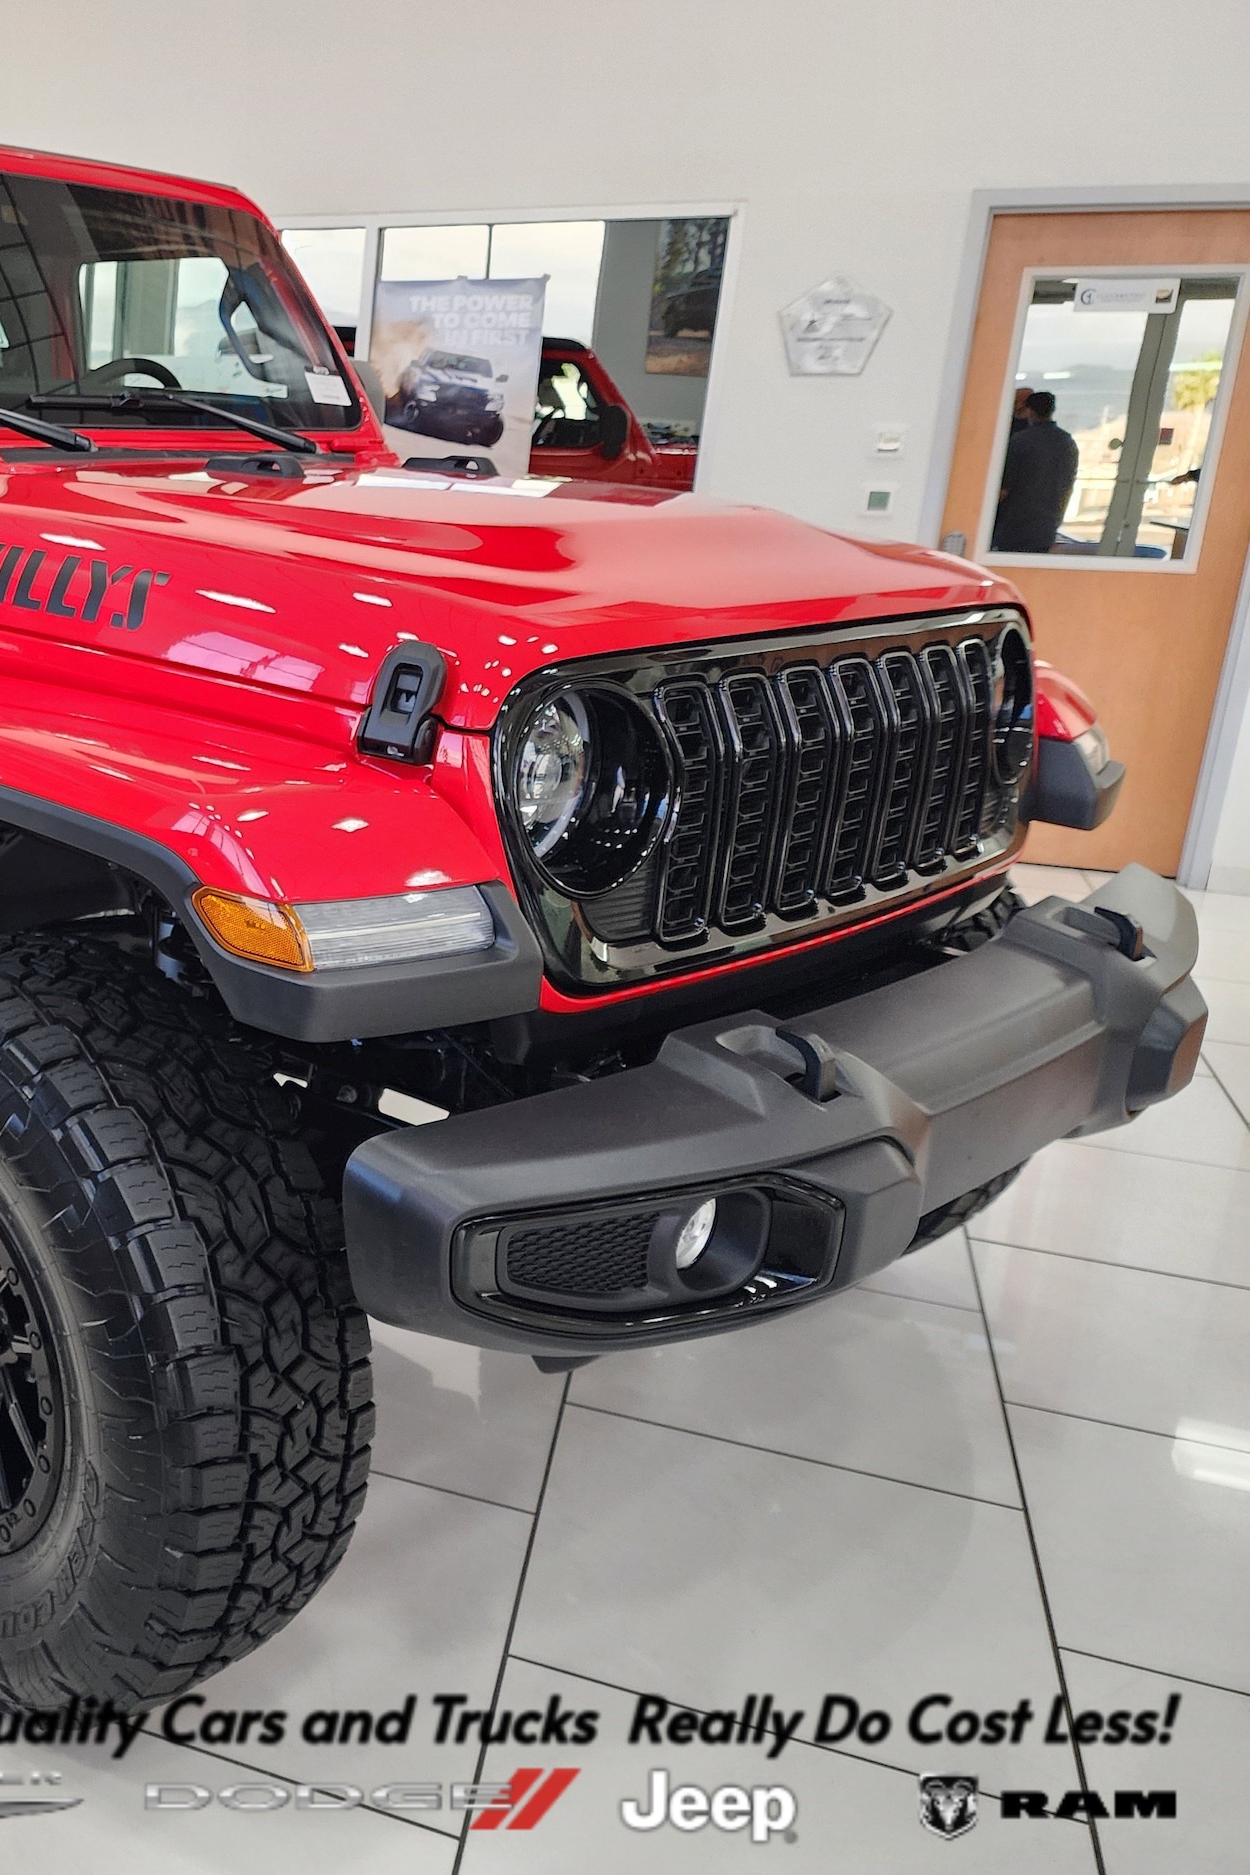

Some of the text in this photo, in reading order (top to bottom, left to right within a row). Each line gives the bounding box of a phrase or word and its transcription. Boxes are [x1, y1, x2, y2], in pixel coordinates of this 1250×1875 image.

[410, 295, 533, 312] THE POWER
[432, 312, 531, 329] TO COME
[469, 330, 530, 345] FIRST
